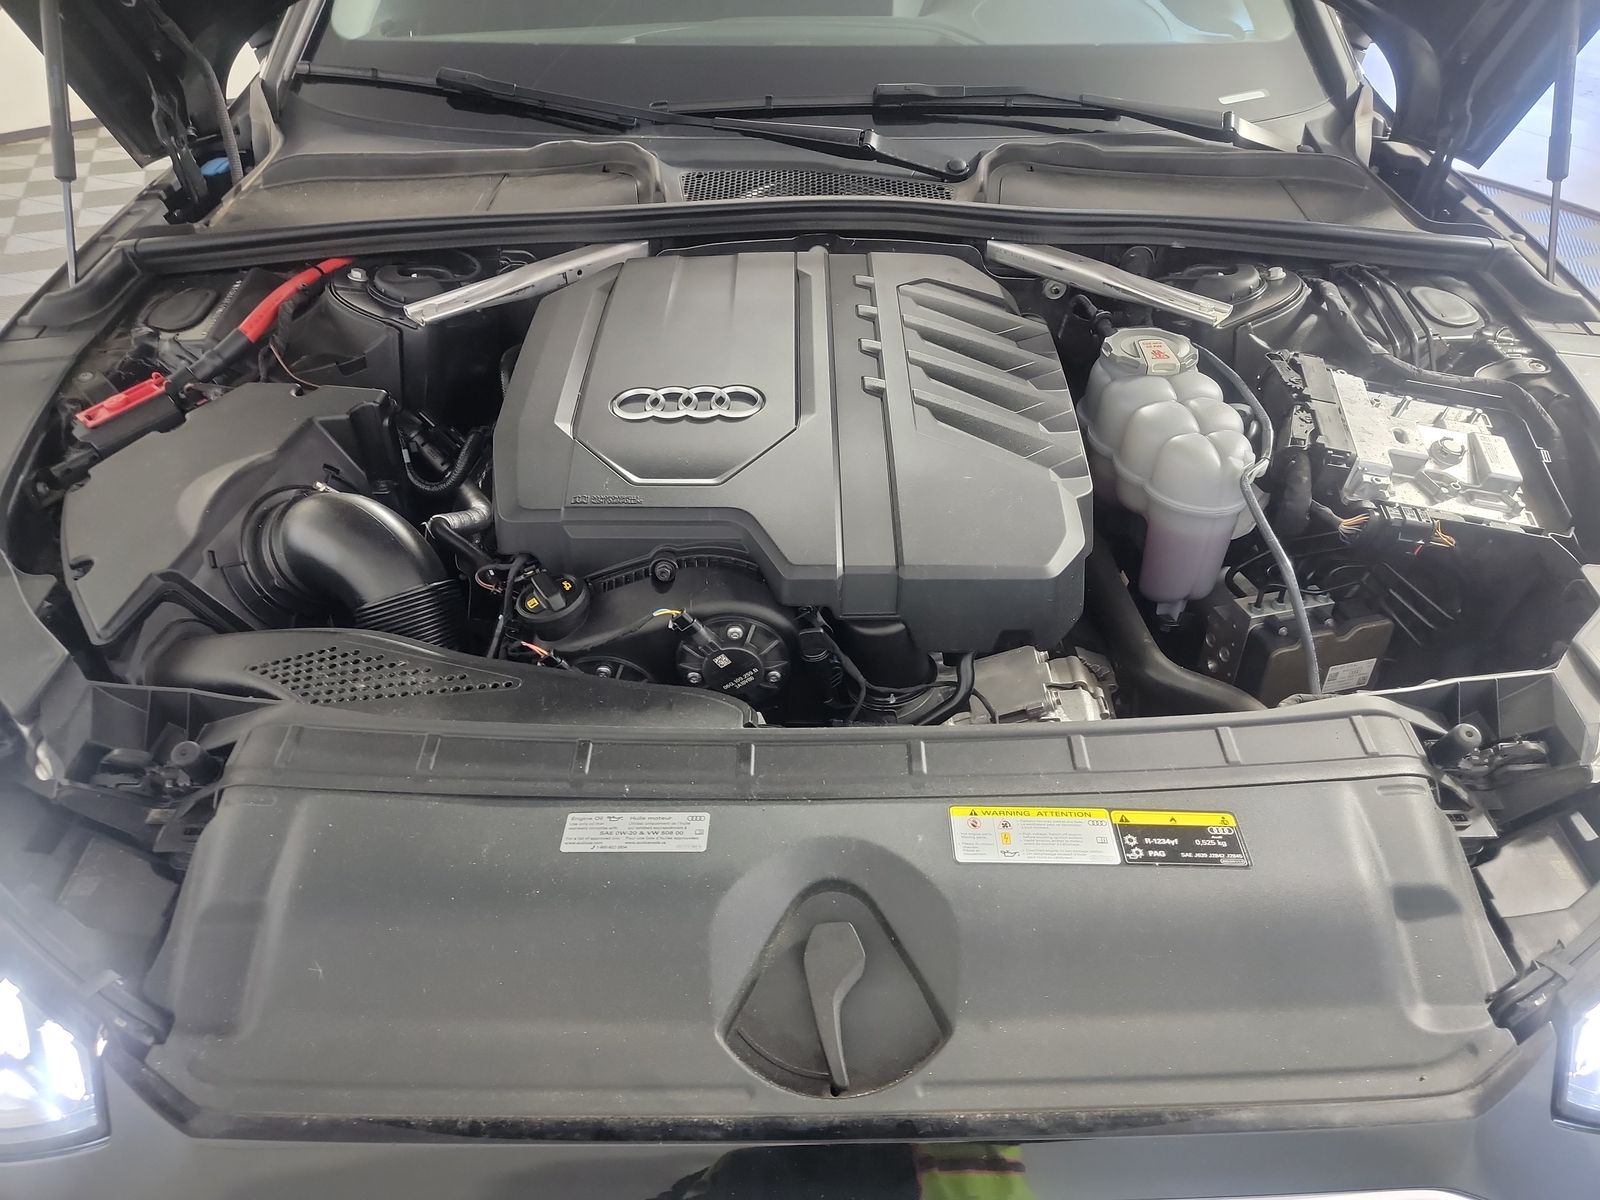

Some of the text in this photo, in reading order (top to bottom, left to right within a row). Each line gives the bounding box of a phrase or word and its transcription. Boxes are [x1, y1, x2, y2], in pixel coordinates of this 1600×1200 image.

[1036, 810, 1092, 818] ATTENTION
[1144, 837, 1179, 846] R-1234yf
[1194, 839, 1228, 847] 0,525 kg
